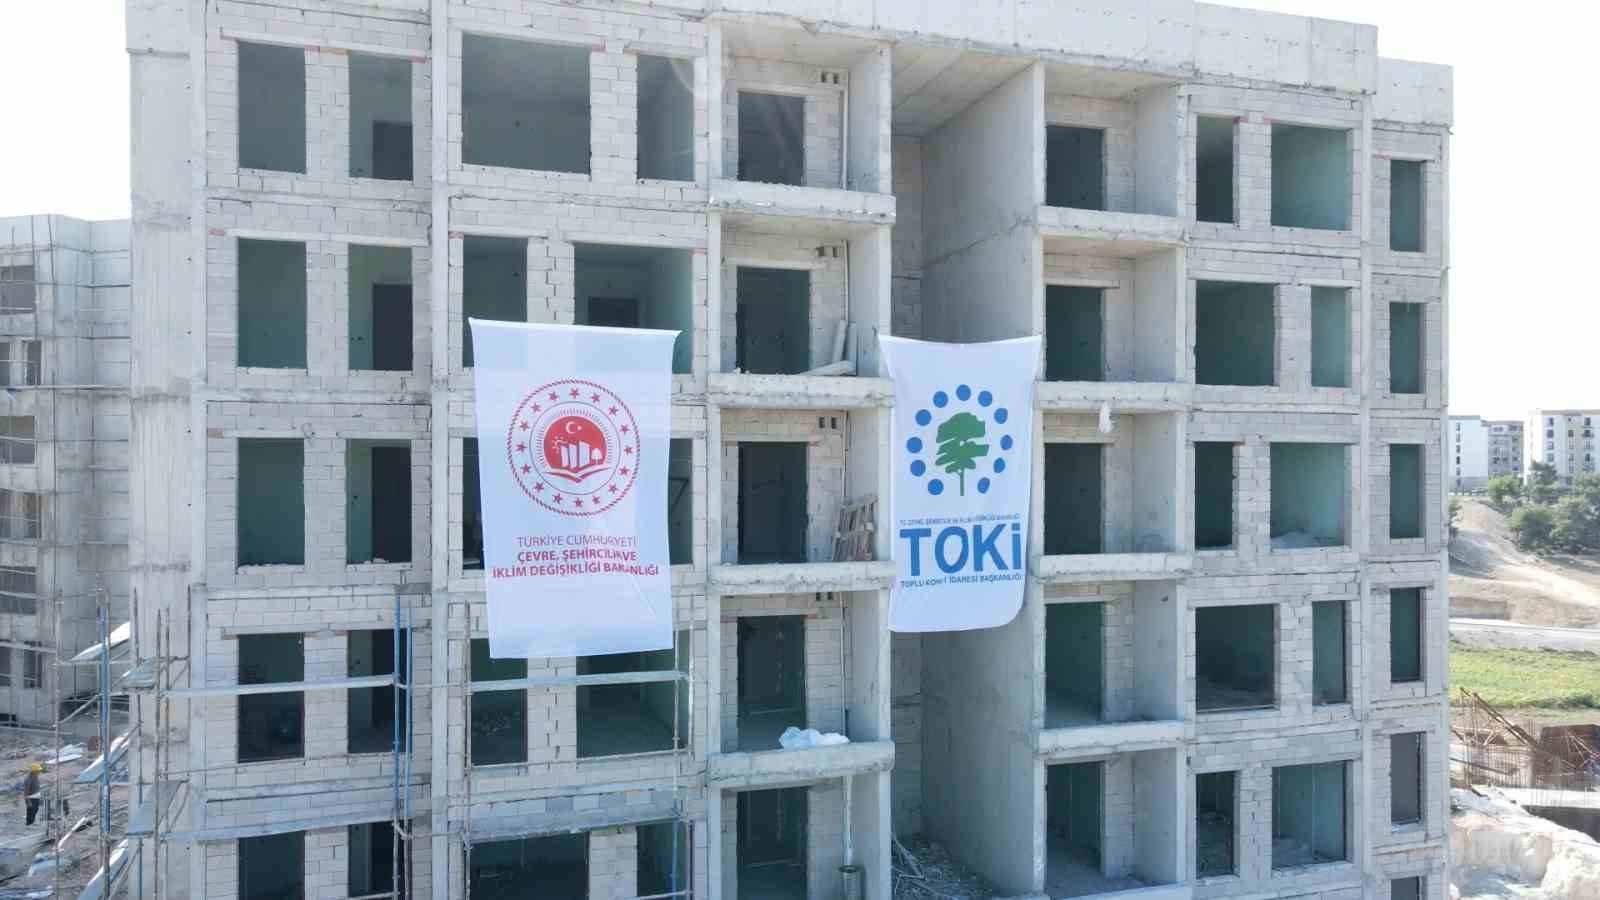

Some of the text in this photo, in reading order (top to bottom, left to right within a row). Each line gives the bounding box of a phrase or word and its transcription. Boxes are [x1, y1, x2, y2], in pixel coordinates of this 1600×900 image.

[517, 534, 637, 548] TÜRKİYE CUMHURYETİ
[623, 551, 637, 561] VE
